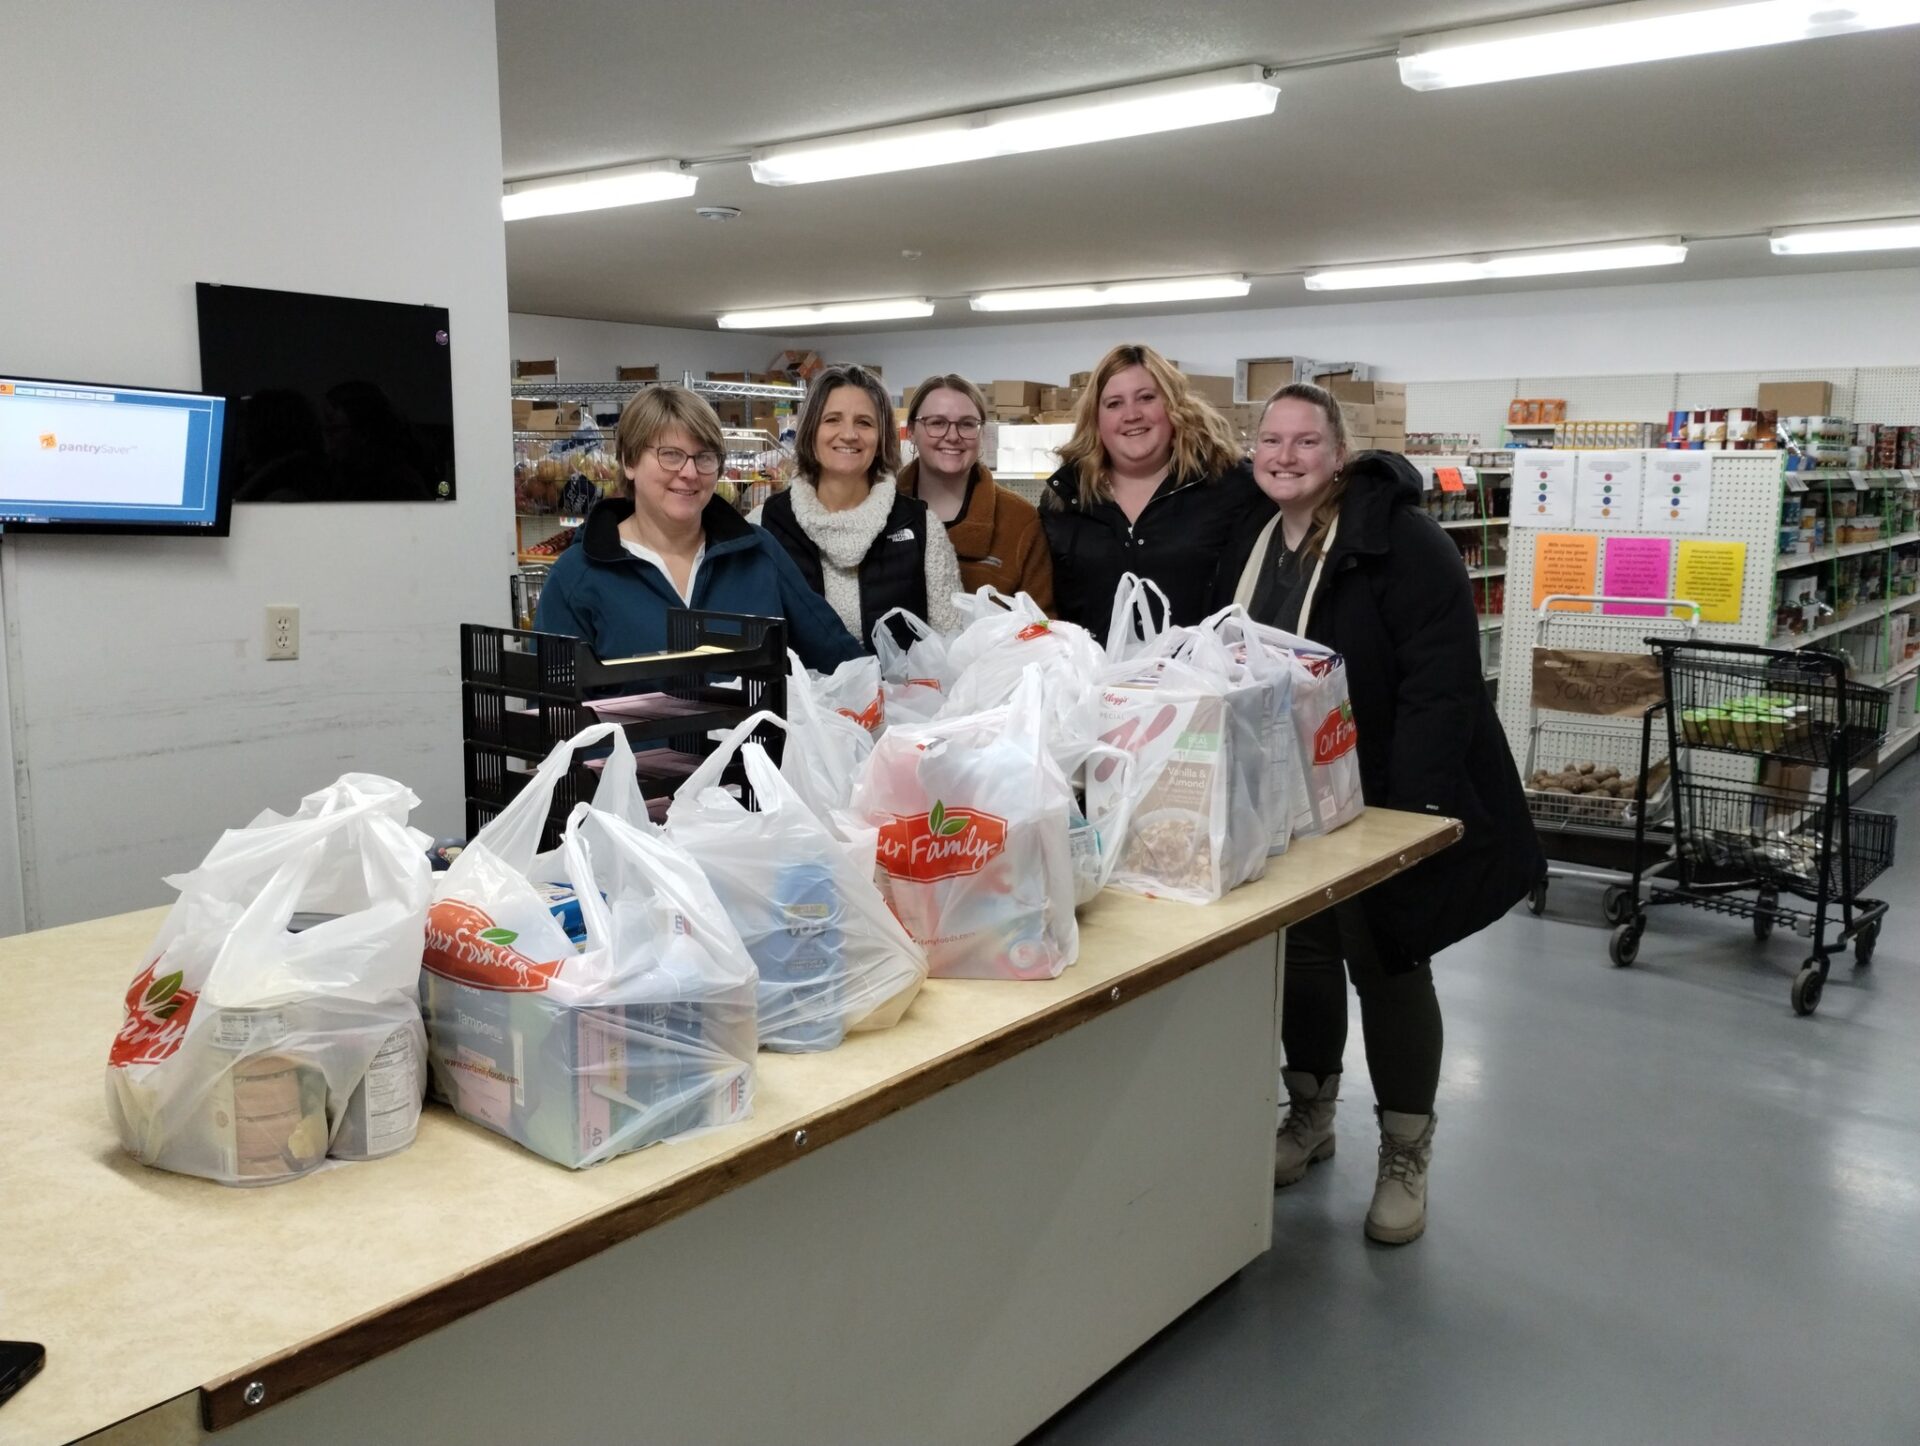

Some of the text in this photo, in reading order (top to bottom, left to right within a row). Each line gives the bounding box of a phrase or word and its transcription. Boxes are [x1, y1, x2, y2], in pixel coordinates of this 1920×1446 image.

[58, 443, 129, 455] pantrySaver
[877, 825, 999, 872] ur Family
